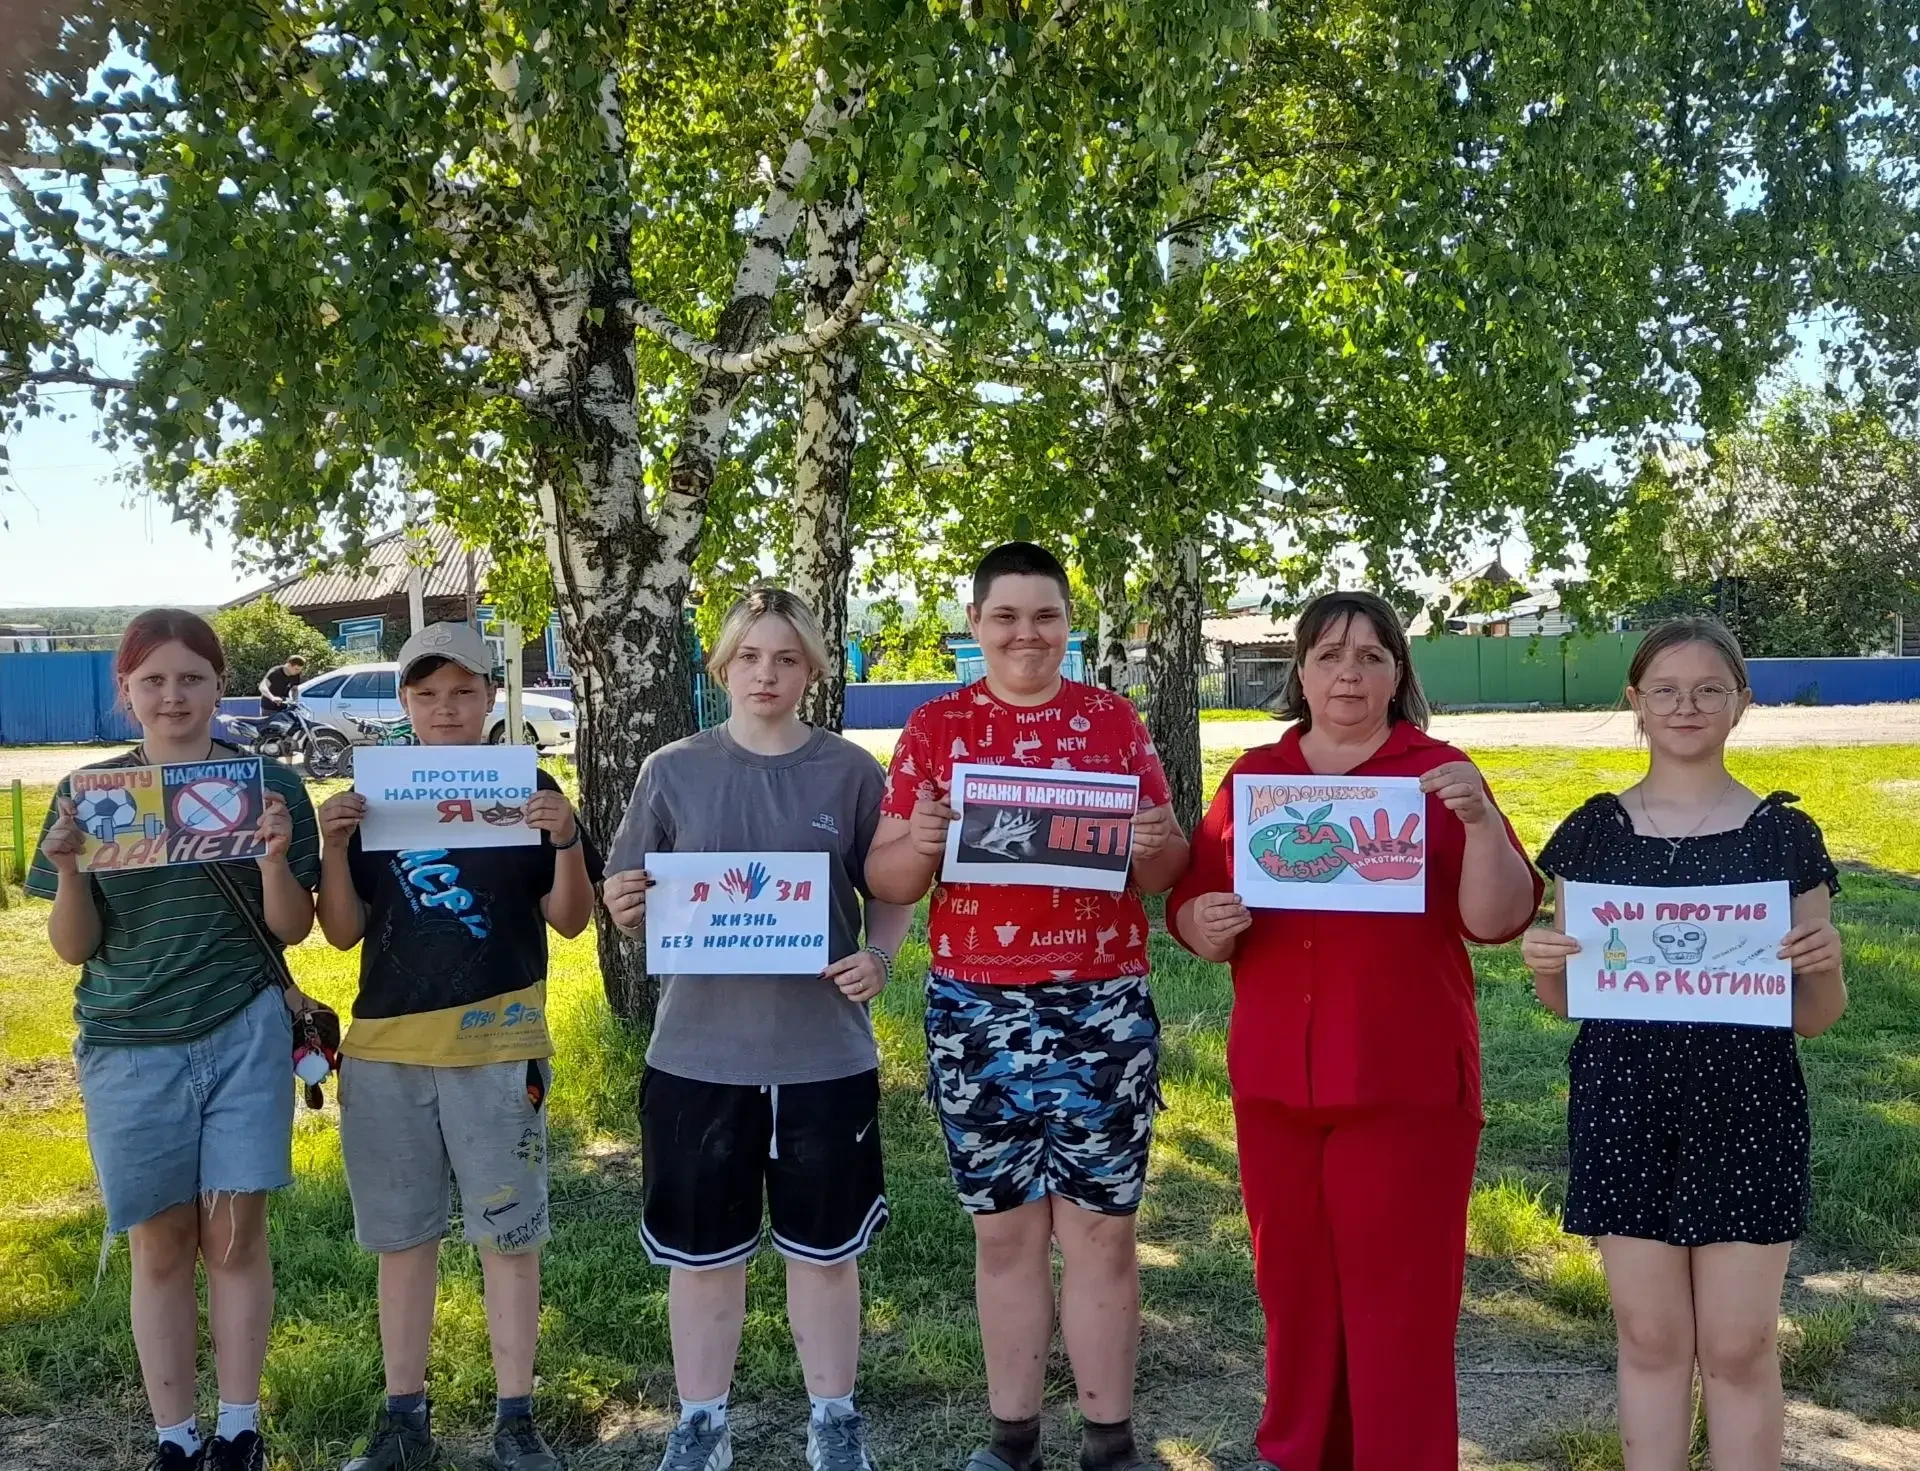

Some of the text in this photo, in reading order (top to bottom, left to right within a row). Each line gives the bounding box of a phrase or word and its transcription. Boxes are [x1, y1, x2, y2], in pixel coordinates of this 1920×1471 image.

[1016, 708, 1062, 724] HAPPY
[1057, 737, 1087, 751] NEW
[163, 761, 258, 785] НАРКОТИКУ
[412, 770, 499, 782] ПРОТИВ
[384, 786, 533, 800] НАРКОТИКОВ
[966, 782, 1134, 810] СКАЖИ НАРКОТИКАМ!
[436, 799, 474, 823] Я
[1047, 815, 1131, 857] НЕТ!
[1292, 824, 1342, 845] ЗА
[87, 829, 169, 871] ДА!
[169, 830, 257, 862] НЕТ!
[1359, 840, 1418, 856] НЕТ
[689, 879, 812, 902] Я ЗА
[950, 897, 980, 916] YEAR
[1591, 900, 1768, 926] МЫ ПРОТИВ
[710, 913, 777, 927] ЖИЗНЬ
[661, 934, 825, 949] БЕЗ НАРКОТИКОВ
[1030, 928, 1087, 947] HAPPY
[1117, 958, 1143, 975] YEAR
[1597, 968, 1786, 996] НАРКОТИКОВ
